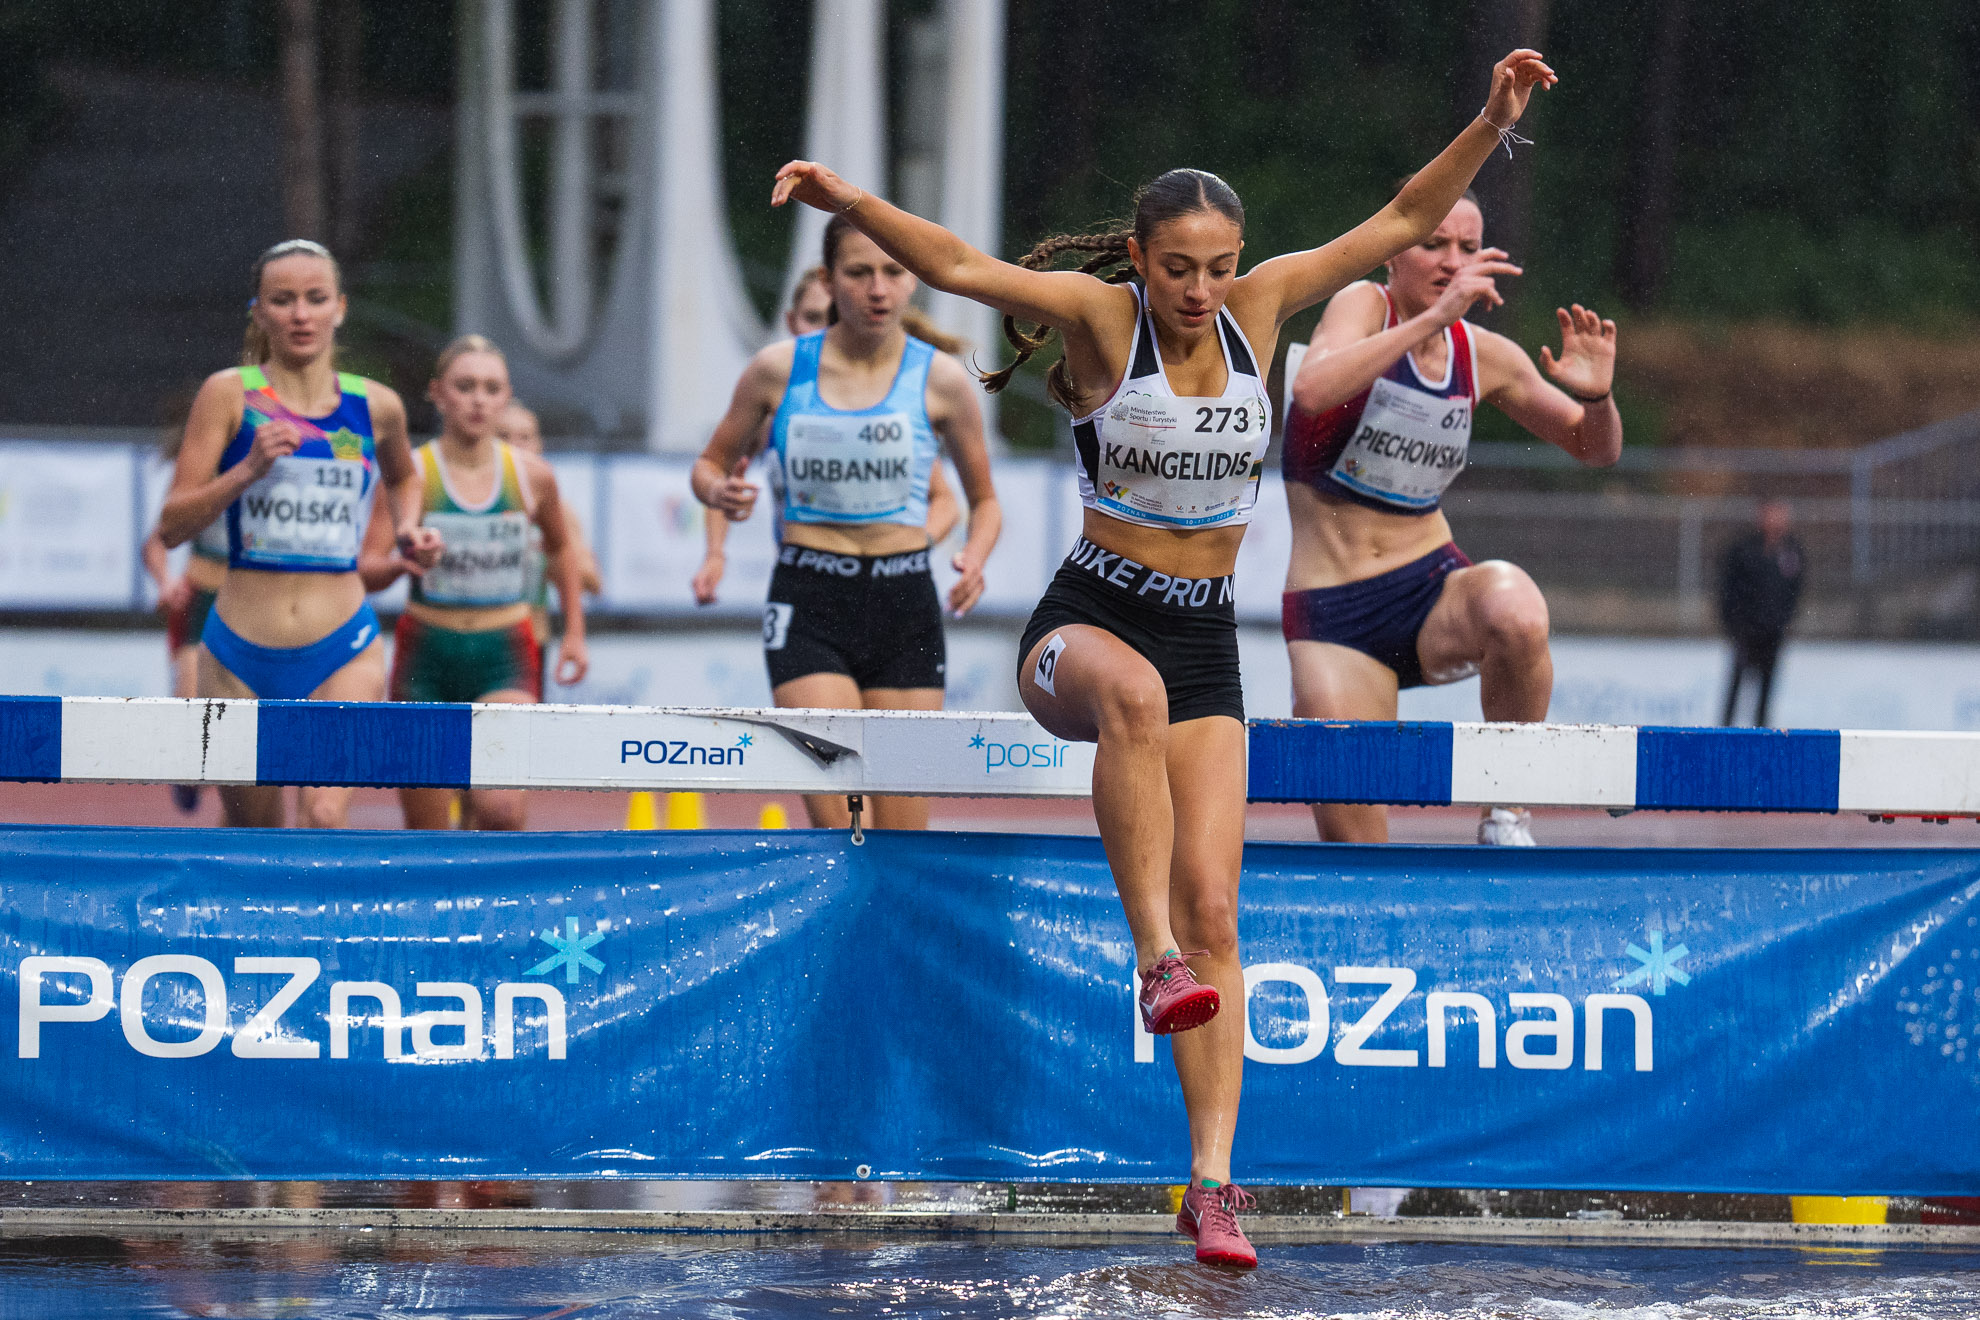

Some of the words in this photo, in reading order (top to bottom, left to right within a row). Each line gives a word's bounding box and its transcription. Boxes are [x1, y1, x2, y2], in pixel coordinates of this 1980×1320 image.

[1129, 412, 1149, 422] Sportu
[1130, 406, 1167, 416] Ministerstwo
[1194, 406, 1249, 433] 273
[859, 422, 902, 443] 400
[790, 456, 908, 482] URBANIK
[1105, 442, 1252, 481] KANGELIDIS
[317, 467, 352, 488] 131
[247, 496, 351, 524] WOLSKA
[797, 551, 862, 577] PRO
[871, 551, 928, 578] NIKE
[1070, 536, 1144, 589] NIKE
[1137, 570, 1212, 608] PRO
[1038, 644, 1056, 682] 5
